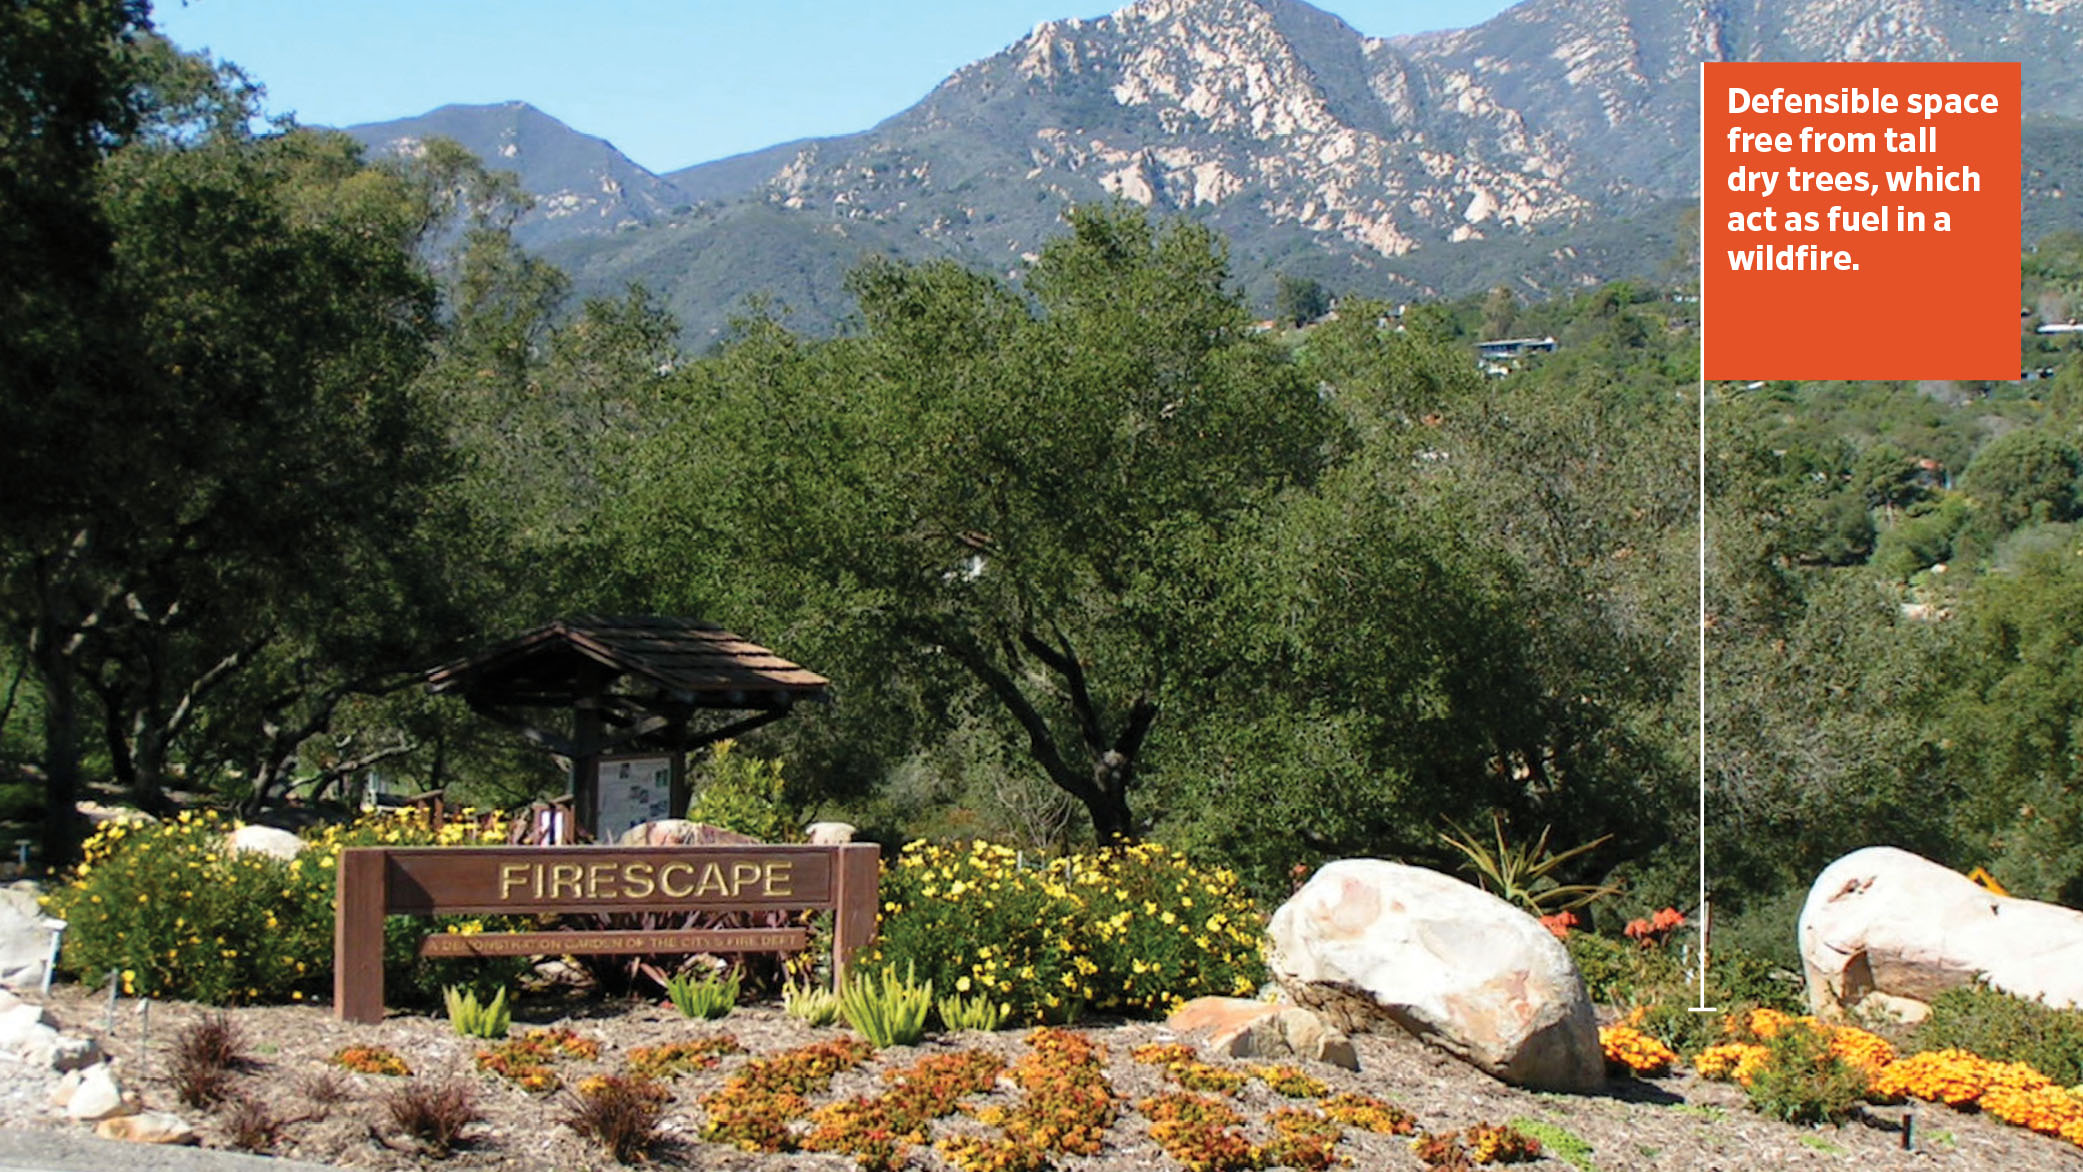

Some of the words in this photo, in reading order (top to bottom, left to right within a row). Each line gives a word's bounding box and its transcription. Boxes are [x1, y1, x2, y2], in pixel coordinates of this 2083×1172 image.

[501, 860, 793, 899] FIRESCAPE
[428, 940, 438, 951] A
[564, 937, 622, 950] GARDEN
[626, 937, 644, 949] OF
[651, 936, 677, 948] THE
[726, 935, 753, 947] FIRE
